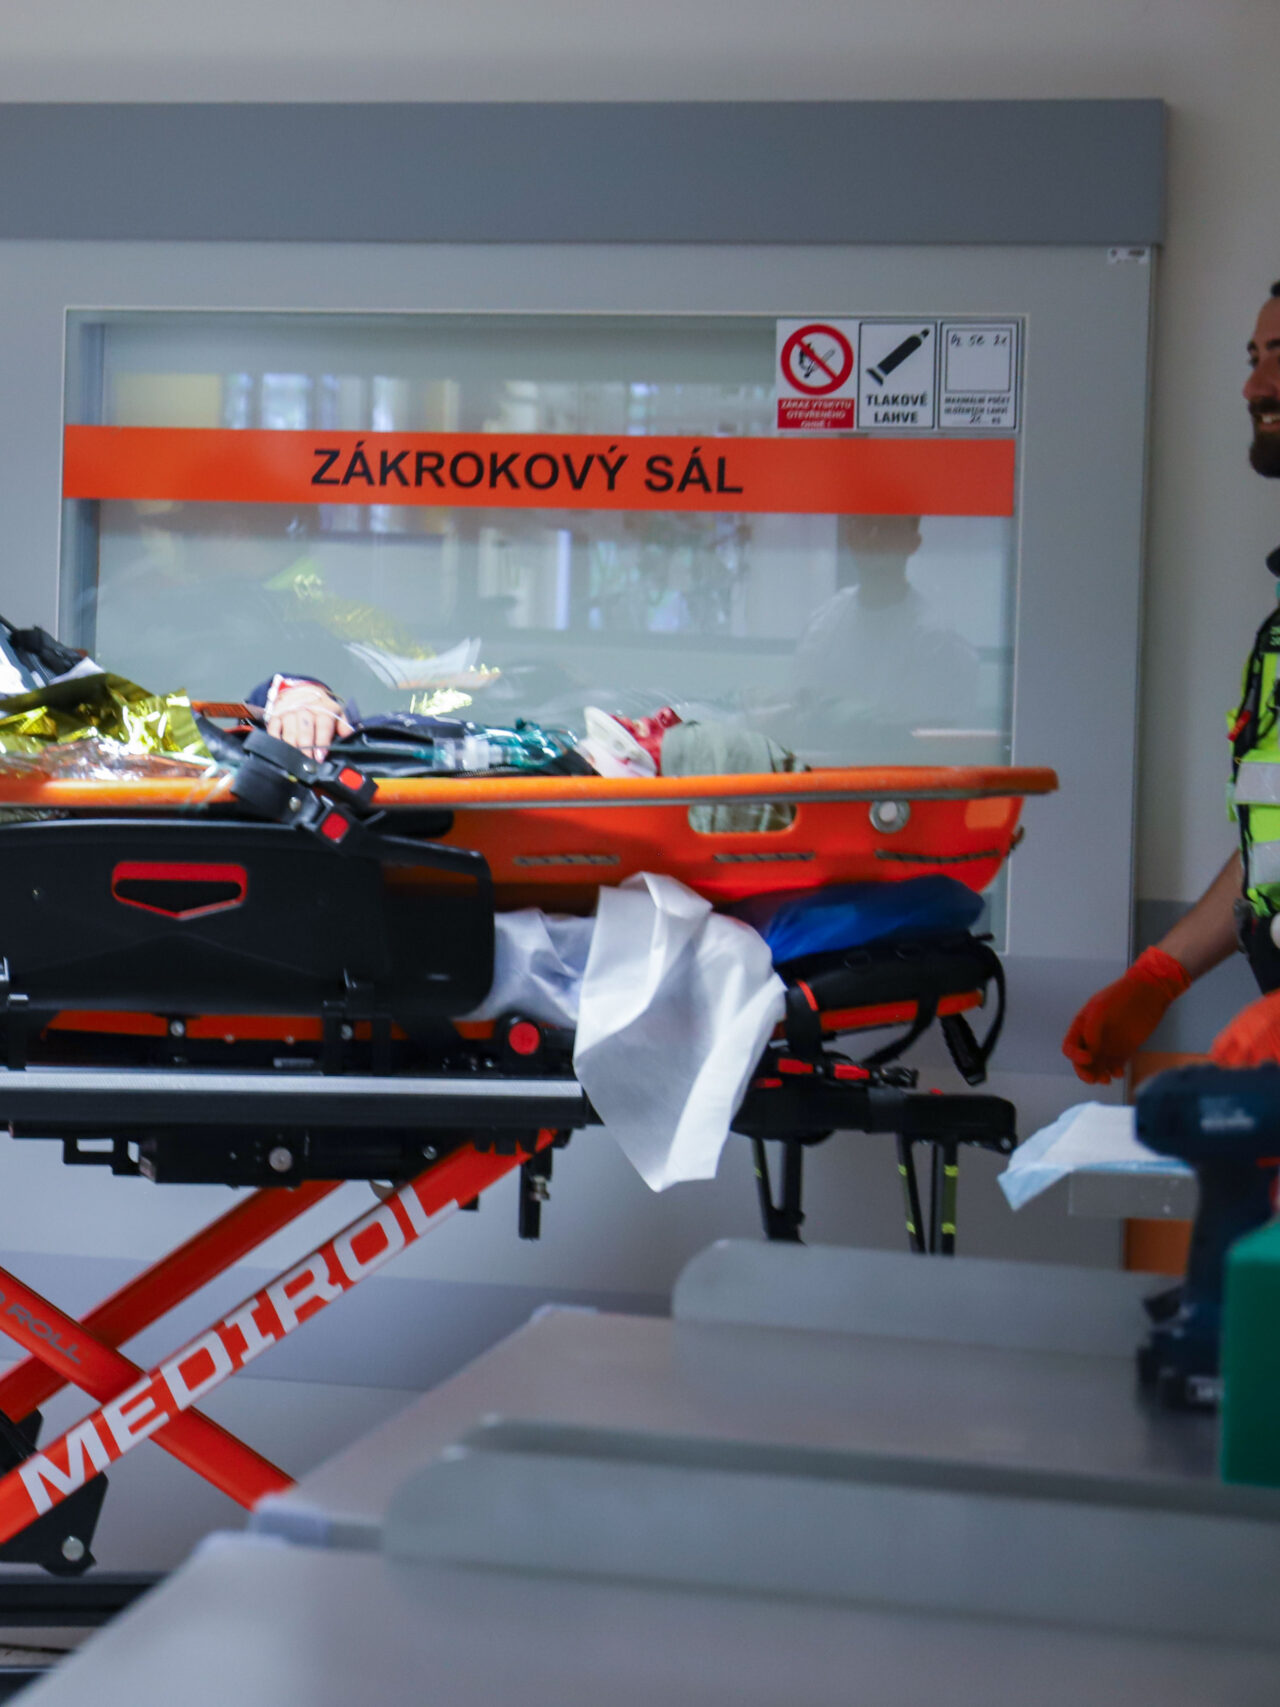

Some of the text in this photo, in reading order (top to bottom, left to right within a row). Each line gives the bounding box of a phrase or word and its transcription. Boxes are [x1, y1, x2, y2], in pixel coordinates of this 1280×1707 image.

[866, 391, 928, 407] TLAKOVÉ
[311, 441, 744, 495] ZÁKROKOVÝ SÁL
[6, 1302, 82, 1365] ROLL
[19, 1185, 459, 1516] MEDIROL
